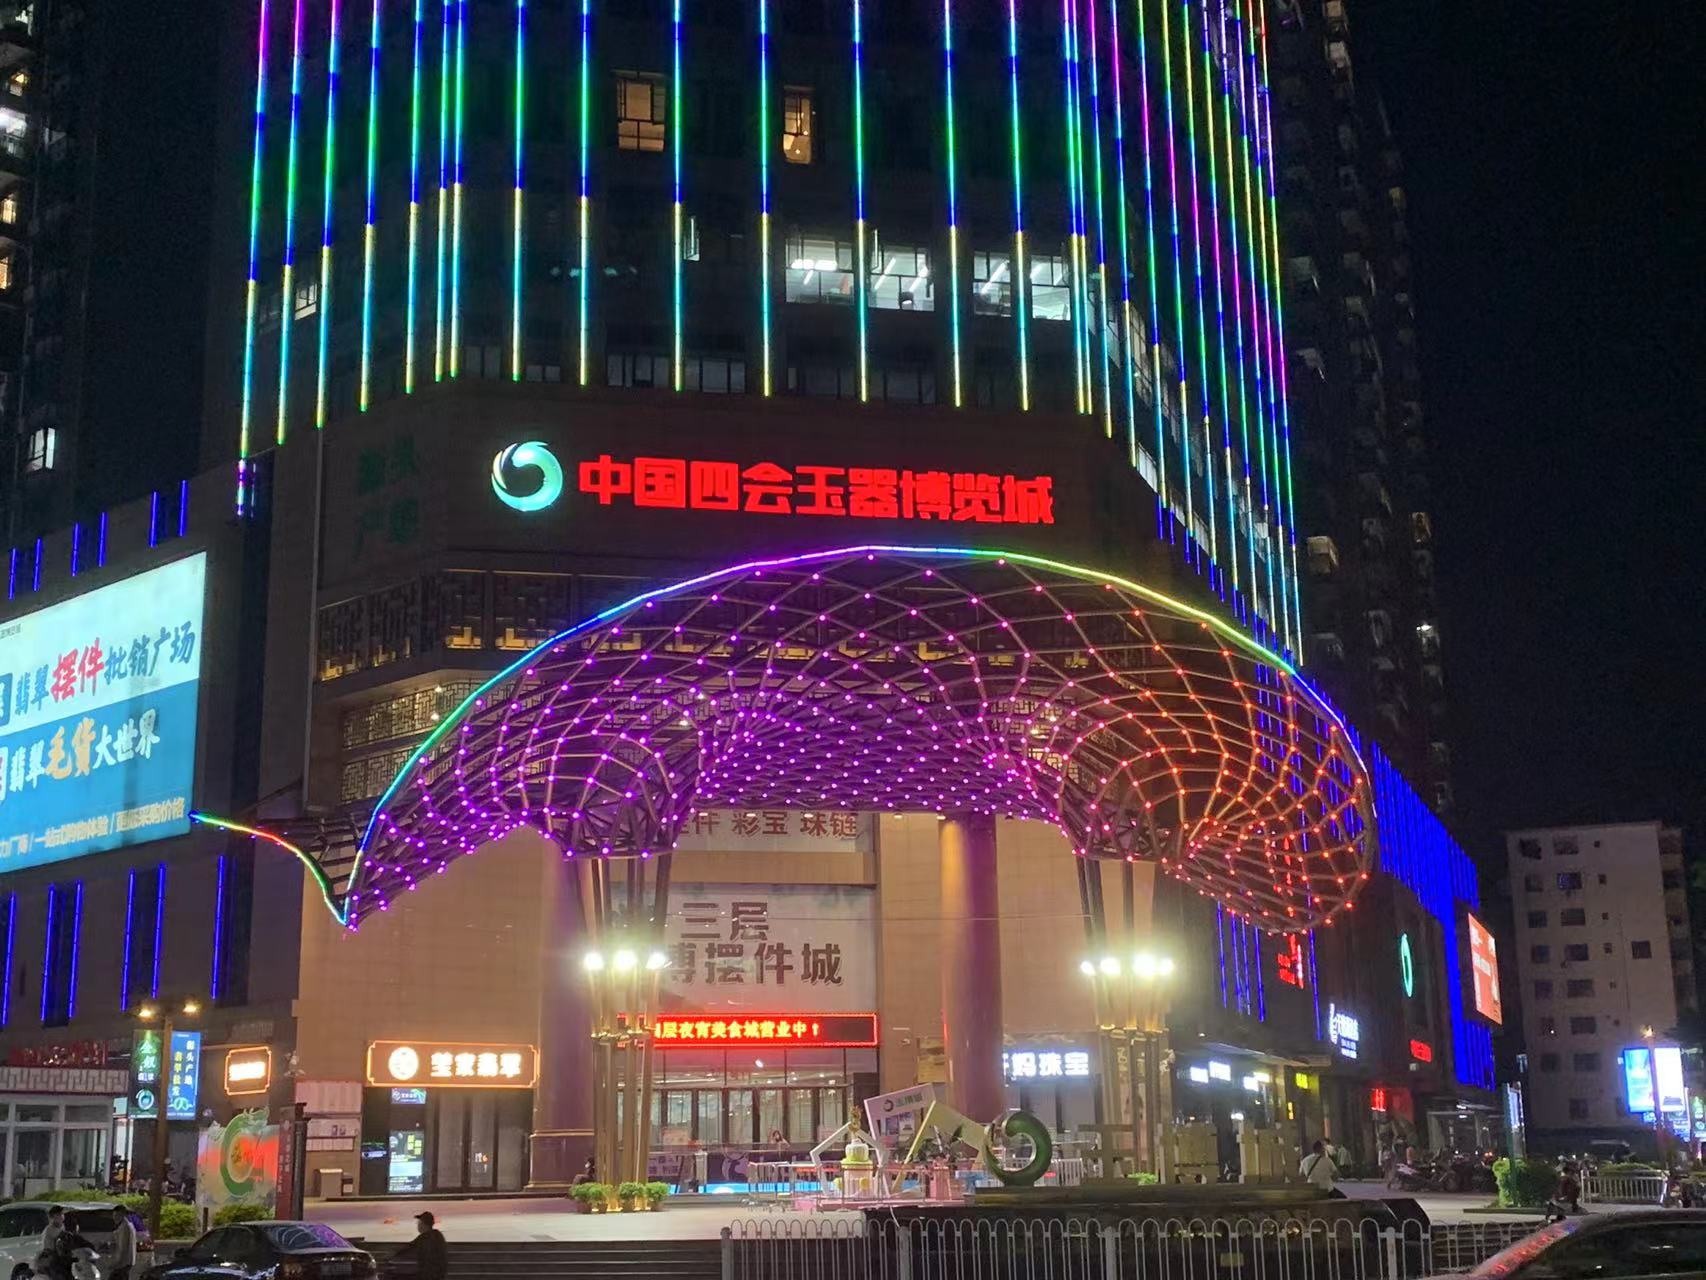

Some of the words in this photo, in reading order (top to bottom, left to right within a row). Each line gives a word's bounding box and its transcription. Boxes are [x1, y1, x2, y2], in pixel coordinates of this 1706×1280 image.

[579, 454, 1054, 524] 中国四会玉器博览城
[731, 810, 788, 836] 彩宝
[680, 901, 769, 941] 三层
